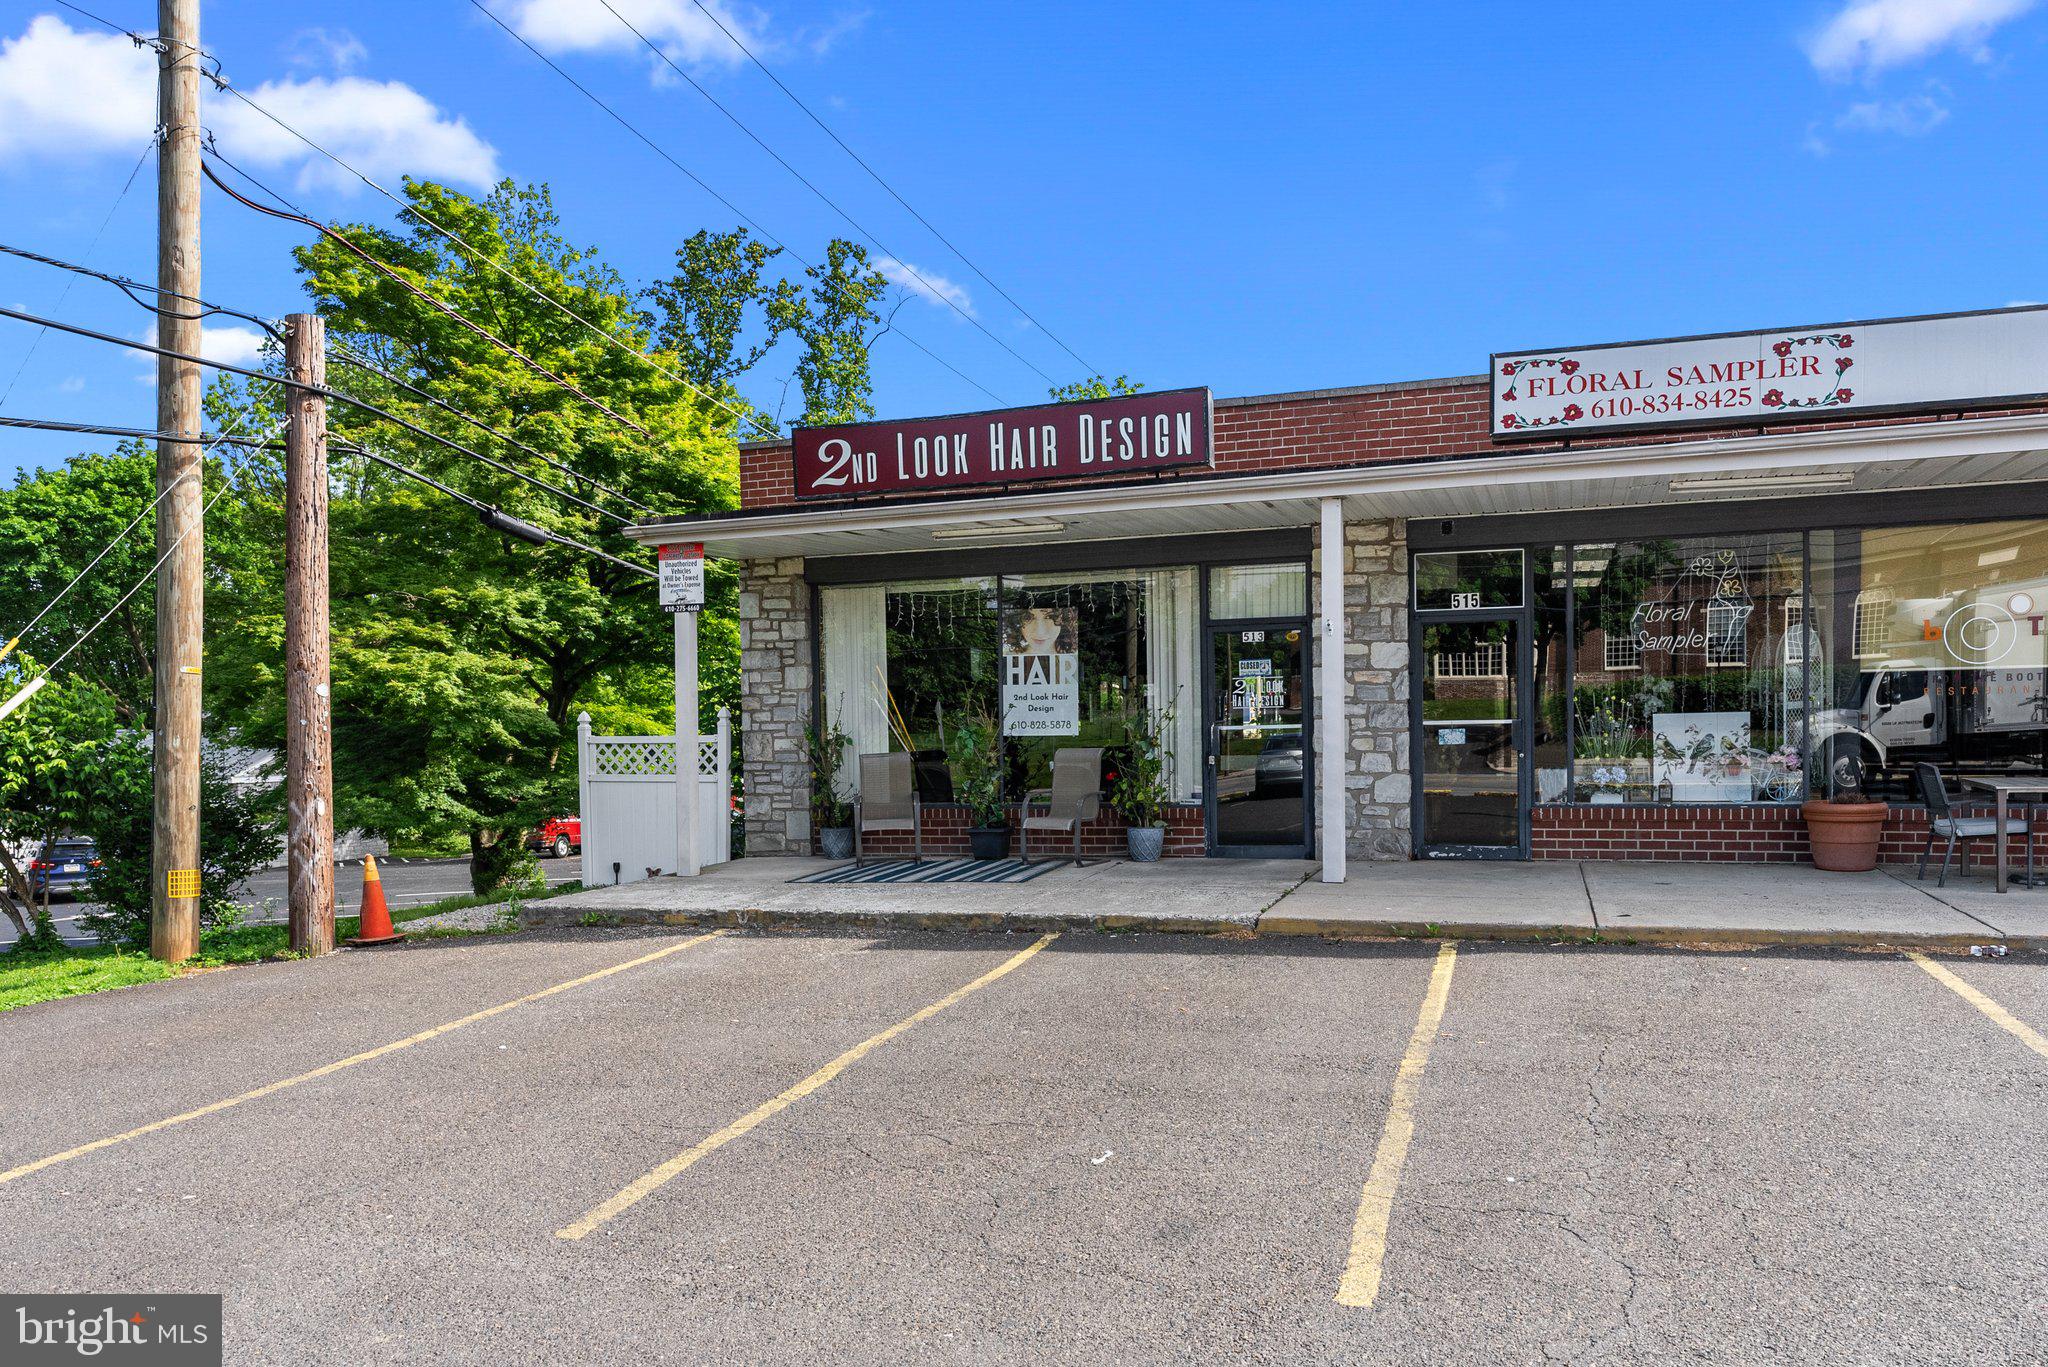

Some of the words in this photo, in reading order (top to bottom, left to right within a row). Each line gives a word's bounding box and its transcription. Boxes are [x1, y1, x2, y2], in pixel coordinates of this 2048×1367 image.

[1527, 368, 1653, 399] FLORAL
[1666, 354, 1823, 387] SAMPLER
[1591, 386, 1752, 420] 610-834-8425
[897, 432, 968, 480] LOOK
[989, 422, 1058, 472] HAIR
[1079, 411, 1192, 464] DESIGN
[664, 560, 698, 568] Unauthorized
[1453, 593, 1479, 609] 515
[1631, 601, 1695, 623] Floral
[1243, 632, 1264, 642] 513
[1634, 628, 1718, 655] Sampler
[1006, 655, 1078, 685] HAIR
[1240, 661, 1259, 670] CLOSED
[2006, 671, 2044, 682] BOOT
[1013, 693, 1028, 701] 2nd
[1030, 693, 1049, 701] Look
[1051, 692, 1069, 700] Hair
[1028, 704, 1054, 712] Design
[1011, 720, 1072, 730] 610-828-5878
